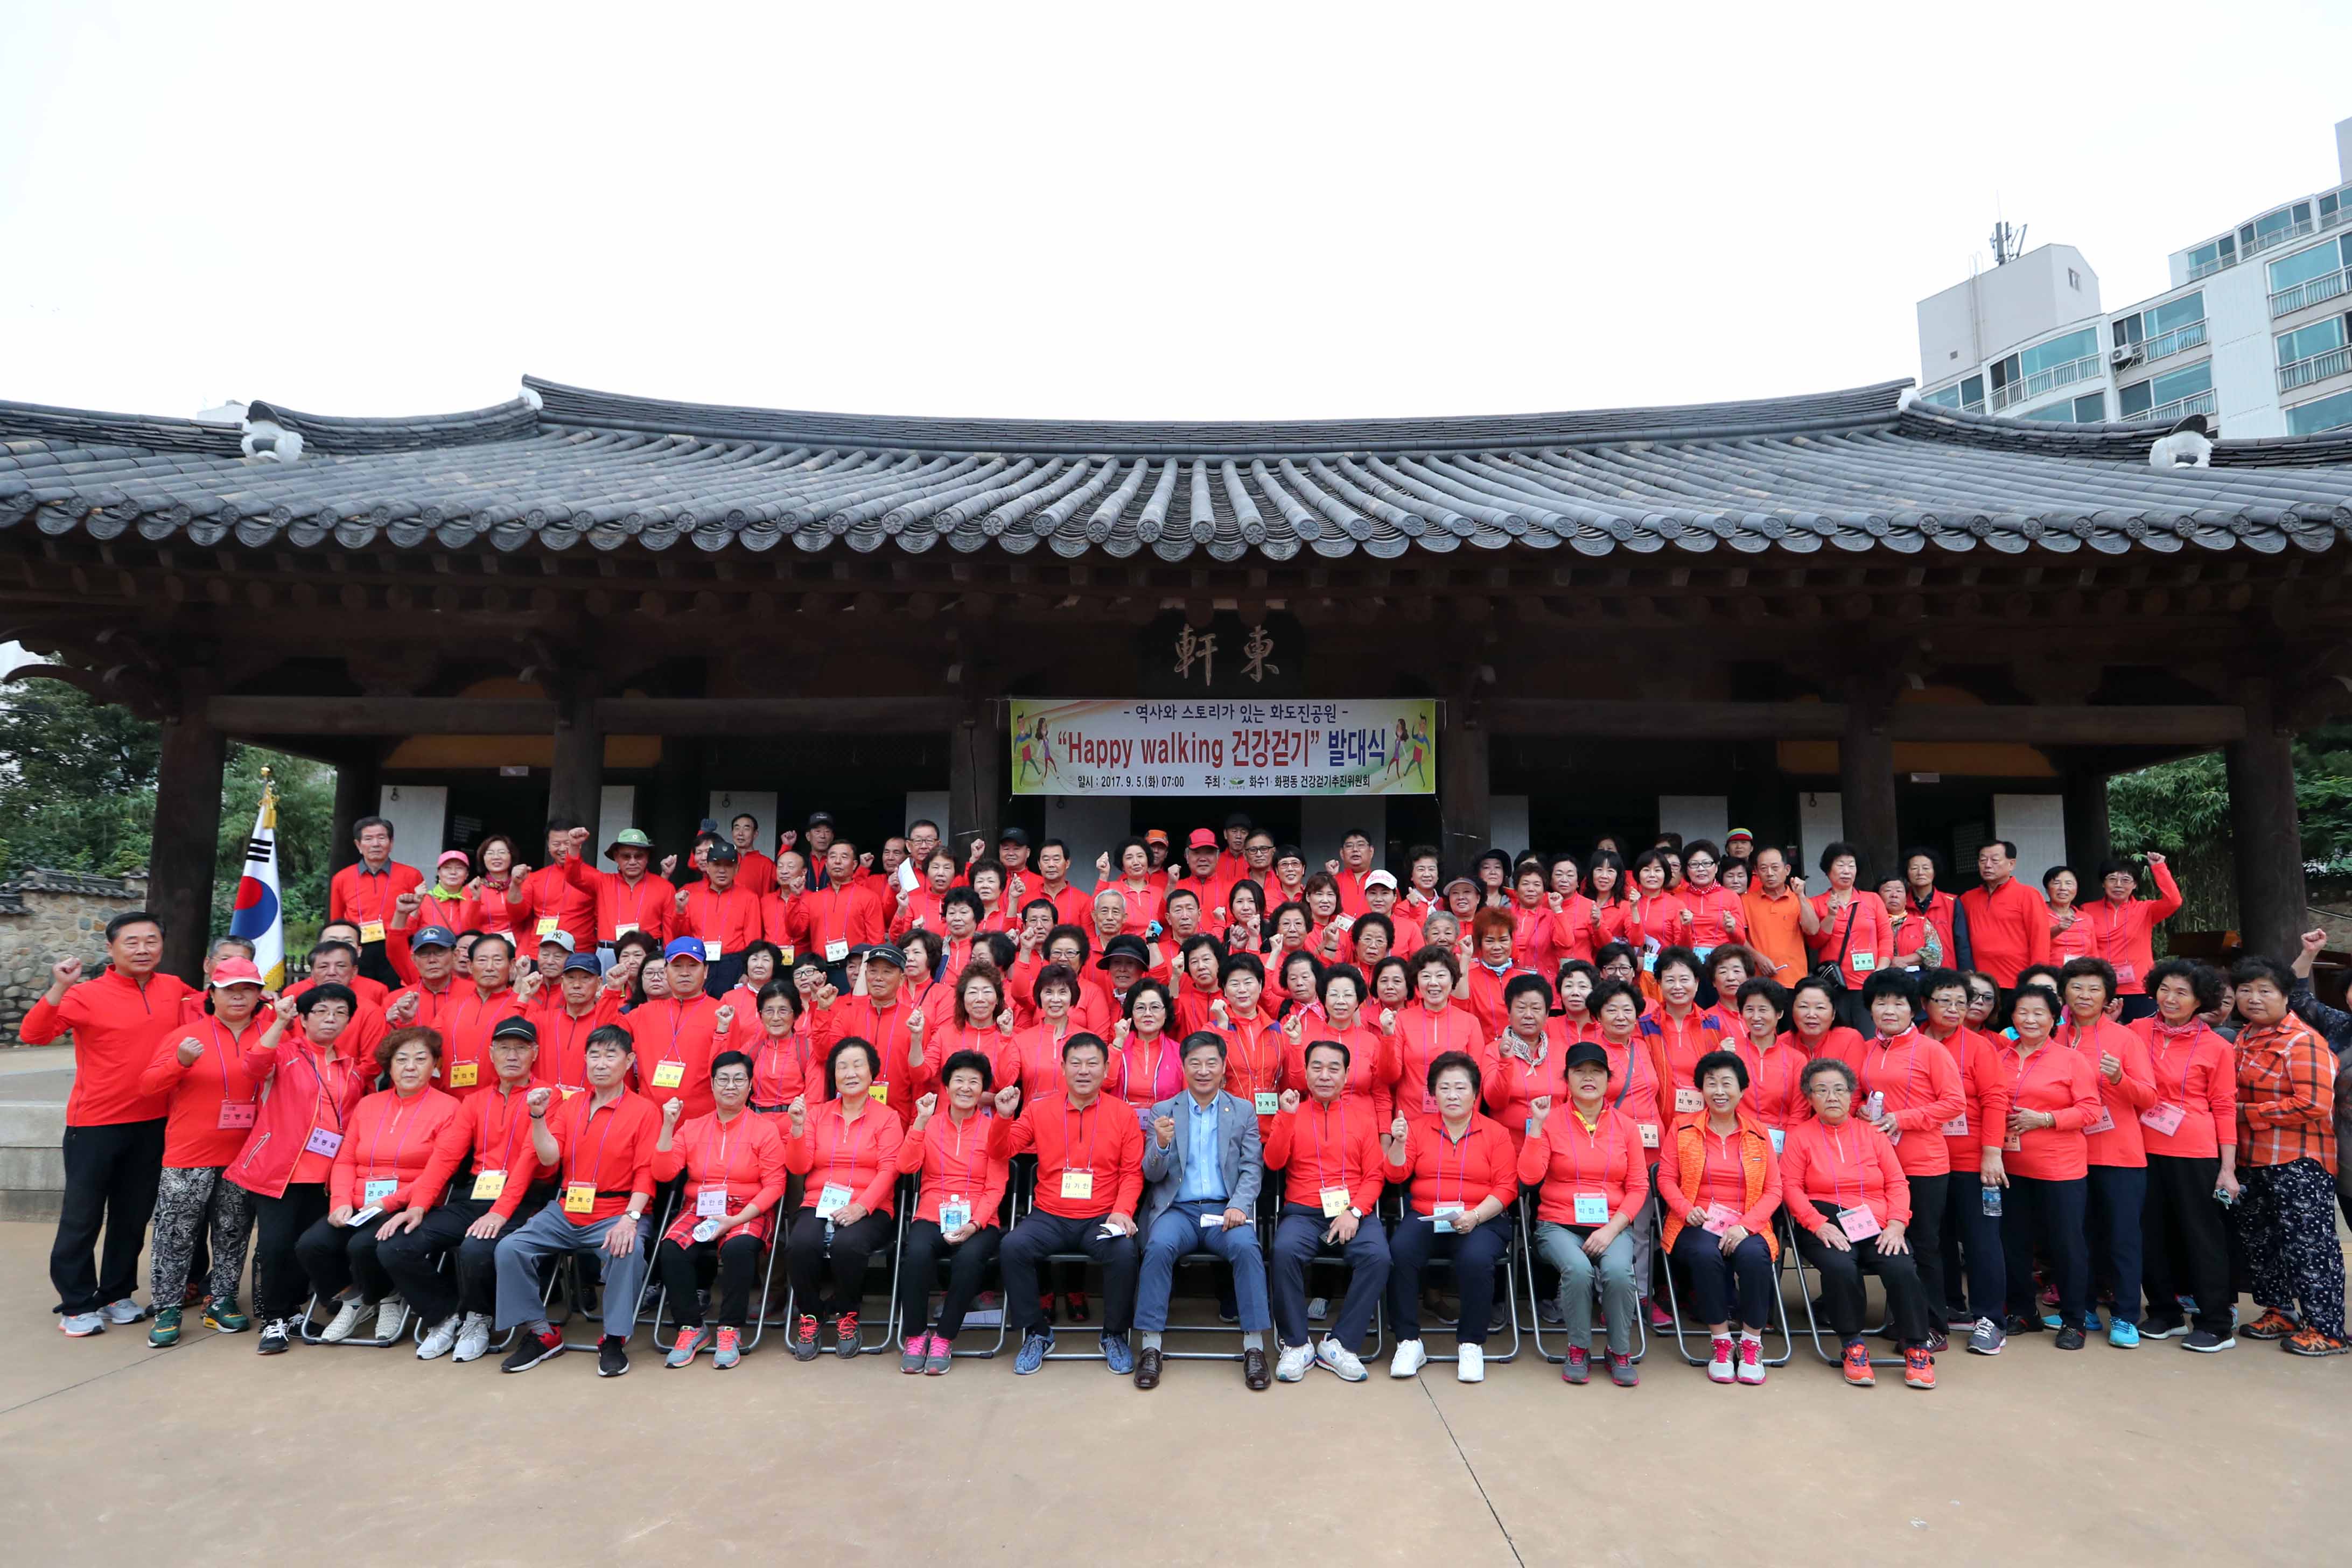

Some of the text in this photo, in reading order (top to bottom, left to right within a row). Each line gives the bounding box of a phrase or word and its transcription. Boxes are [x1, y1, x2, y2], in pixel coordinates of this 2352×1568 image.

[1136, 704, 1177, 724] 역사와
[1181, 704, 1235, 720] 스토리가
[1240, 704, 1265, 723] 있는
[1270, 704, 1336, 724] 화도진공원
[1141, 732, 1223, 769] walking
[1328, 729, 1385, 767] 발대식
[1078, 775, 1093, 788] 일시
[1101, 776, 1123, 787] 2017.
[1126, 776, 1133, 787] 9.
[1162, 776, 1185, 787] 07:00
[1205, 775, 1220, 788] 주최
[1275, 775, 1298, 788] 화평동
[1300, 775, 1370, 788] 건강걷기추진위원회
